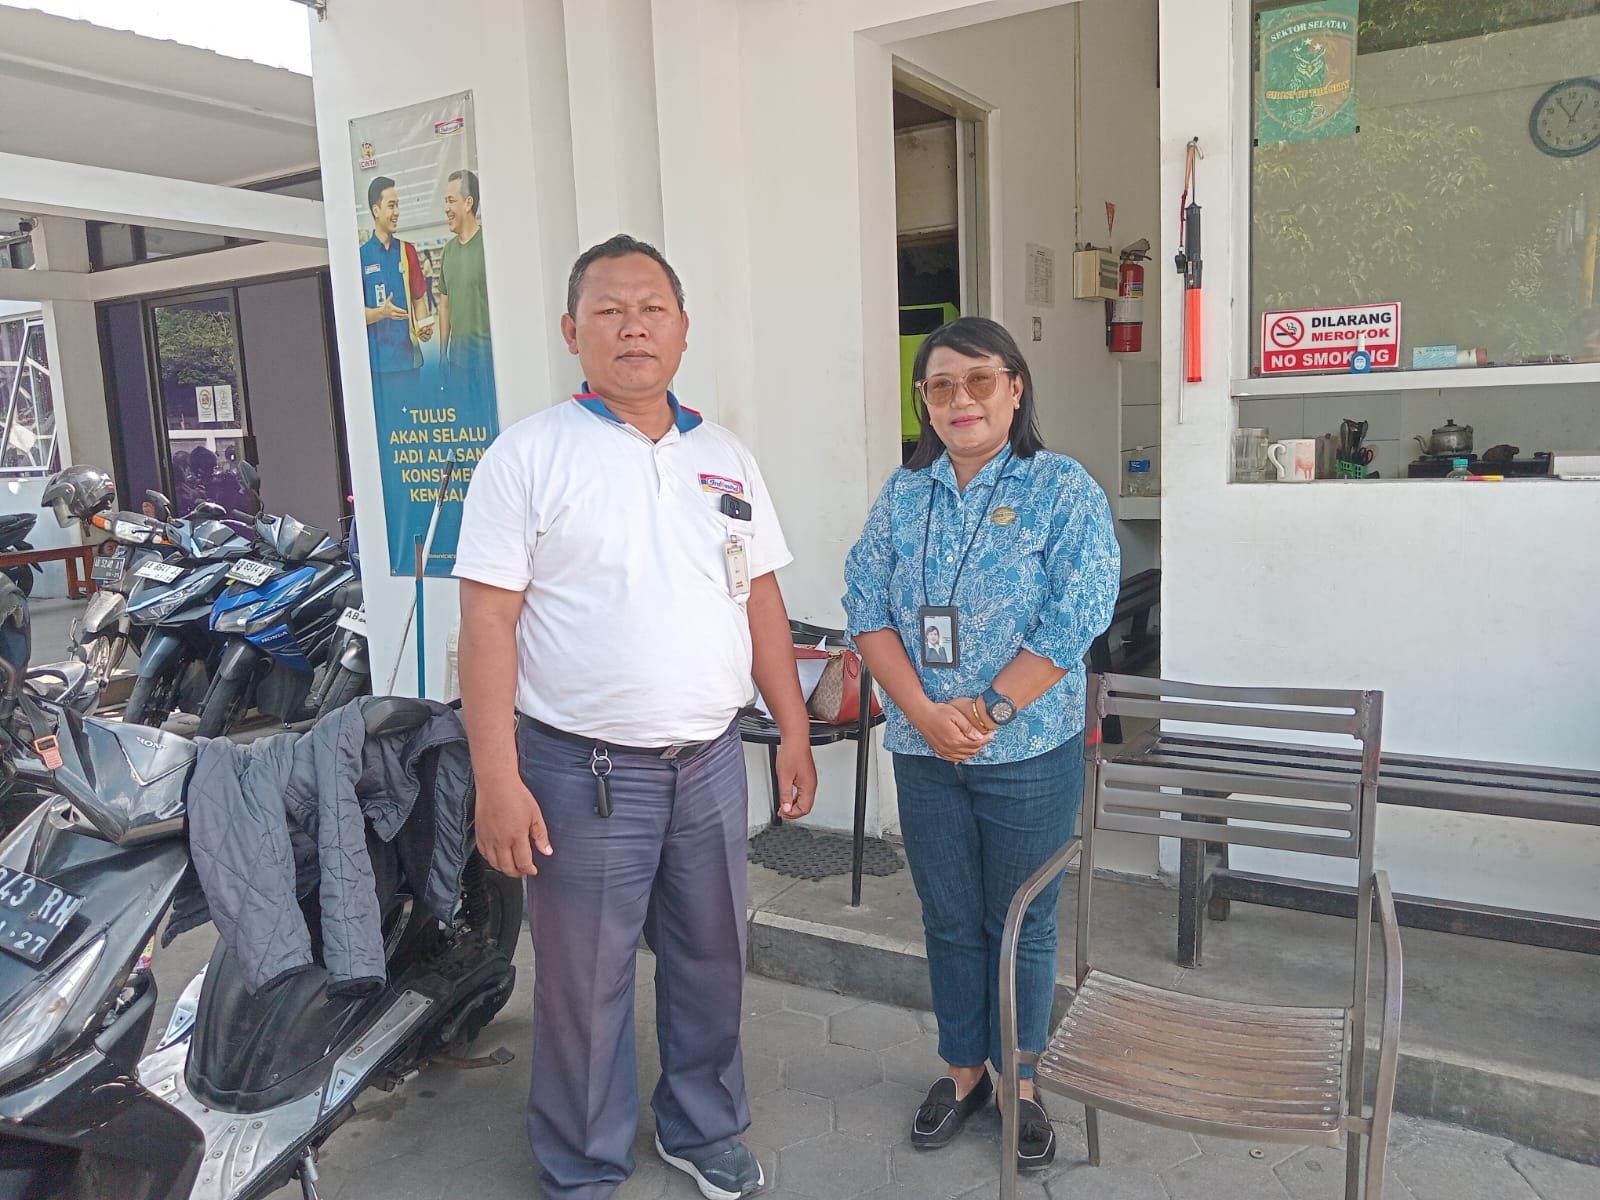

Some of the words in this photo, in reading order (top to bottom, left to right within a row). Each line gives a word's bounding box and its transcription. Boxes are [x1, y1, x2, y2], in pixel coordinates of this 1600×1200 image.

[1270, 23, 1307, 42] SEKTOR
[1308, 20, 1348, 30] SELATAN
[1312, 312, 1392, 328] DILARANG
[1271, 354, 1297, 368] NO
[1302, 349, 1390, 367] SMOKG
[409, 408, 457, 424] TULUS
[390, 429, 428, 445] AKAN
[432, 427, 487, 443] SELALU
[393, 449, 423, 464] JADI
[427, 447, 487, 463] ALSAN
[401, 467, 475, 483] KONSME
[345, 610, 360, 620] AB
[261, 631, 289, 644] HONDA
